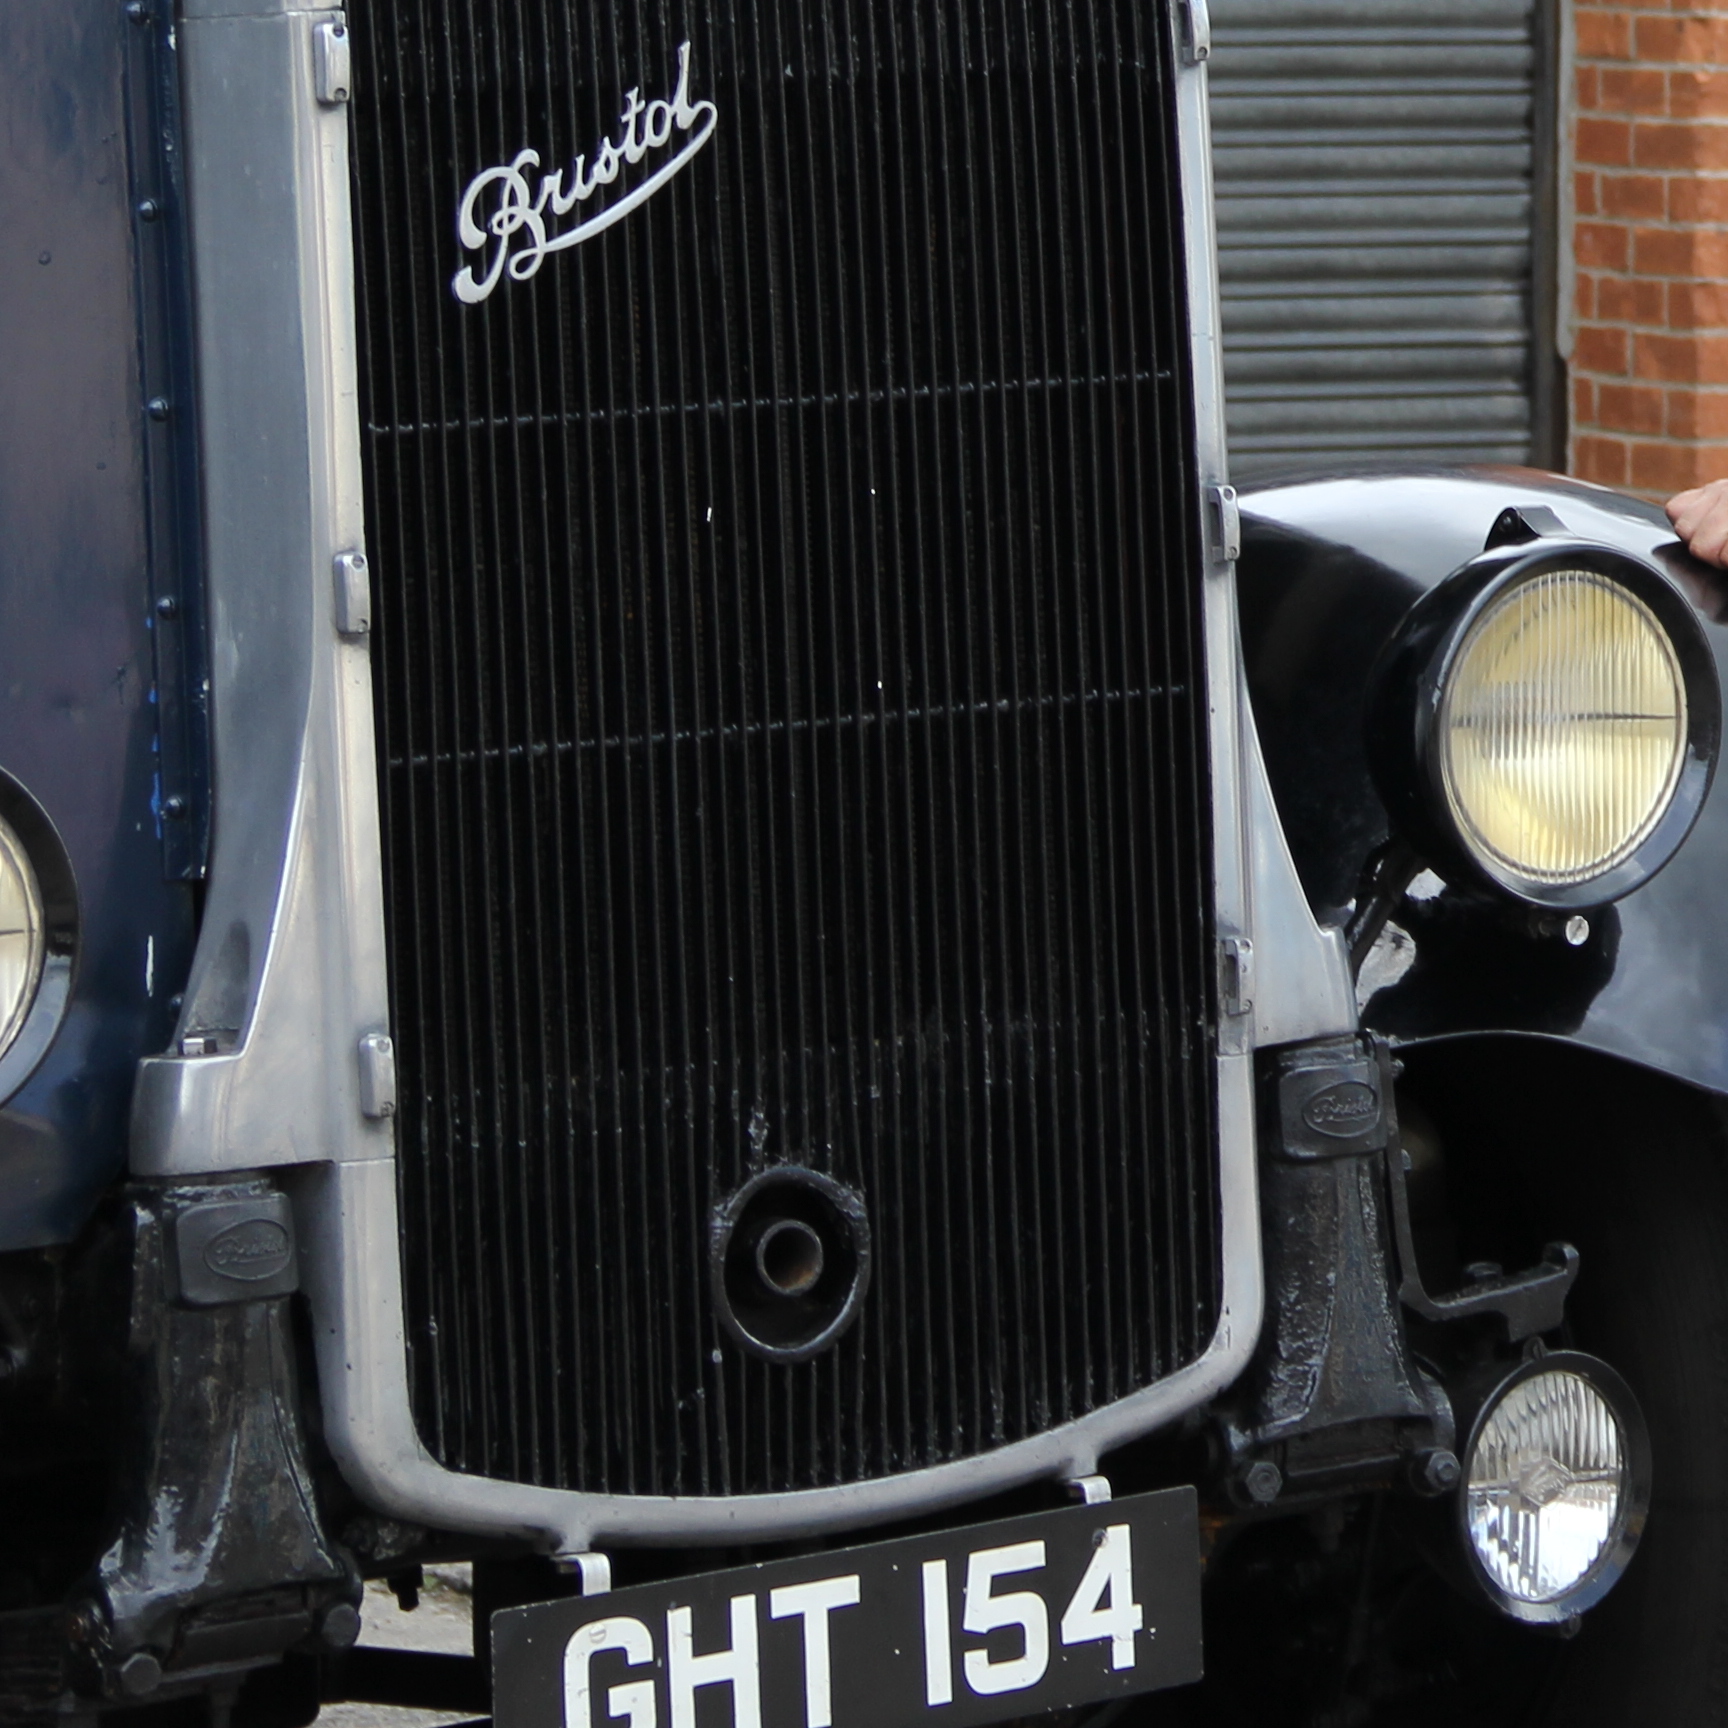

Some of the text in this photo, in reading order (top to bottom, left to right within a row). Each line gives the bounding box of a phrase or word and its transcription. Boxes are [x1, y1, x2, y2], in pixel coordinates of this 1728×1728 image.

[452, 41, 718, 304] Bristol
[564, 1524, 1143, 1728] GHT 154
